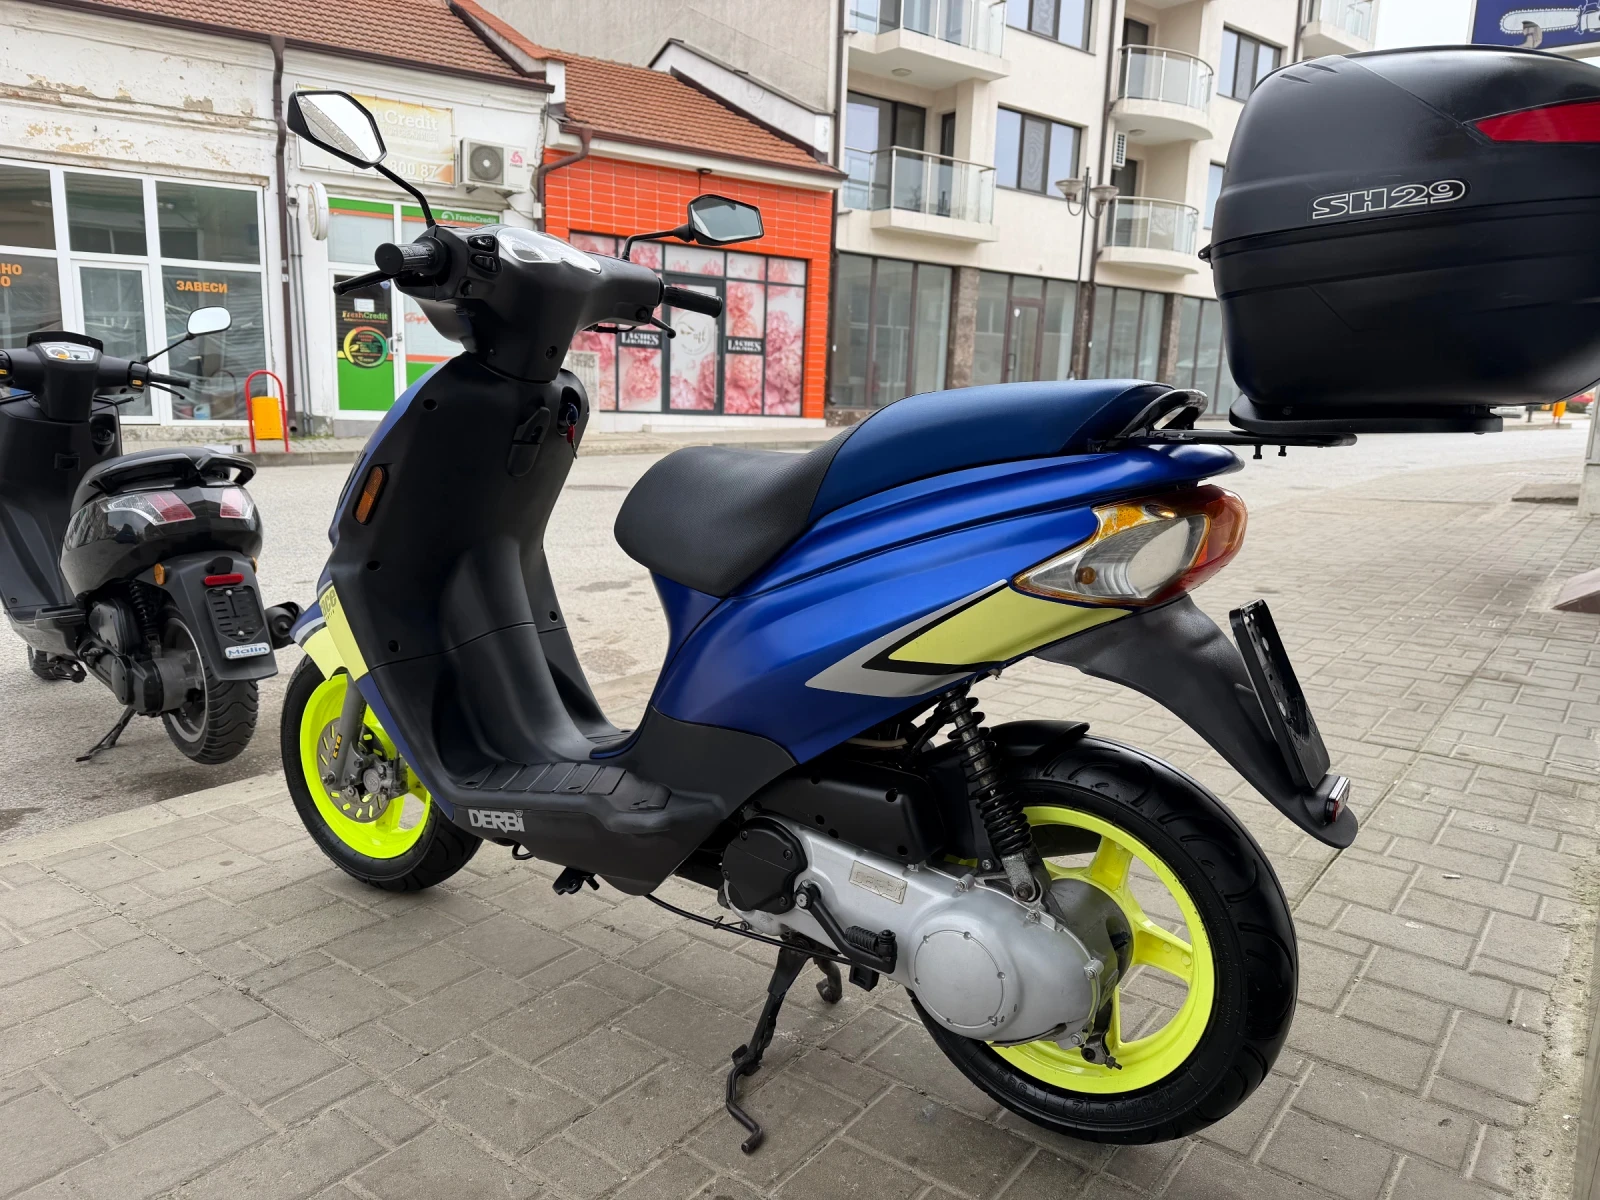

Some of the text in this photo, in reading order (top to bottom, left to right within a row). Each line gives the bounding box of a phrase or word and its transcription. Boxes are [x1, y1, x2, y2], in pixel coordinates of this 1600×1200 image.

[373, 105, 439, 131] hCredit
[1312, 179, 1466, 220] SH29
[455, 213, 497, 224] FreshCredit
[0, 262, 22, 276] НО
[176, 279, 228, 294] ЗАВЕСИ
[342, 310, 388, 321] FreshCredit
[228, 646, 268, 658] Malin
